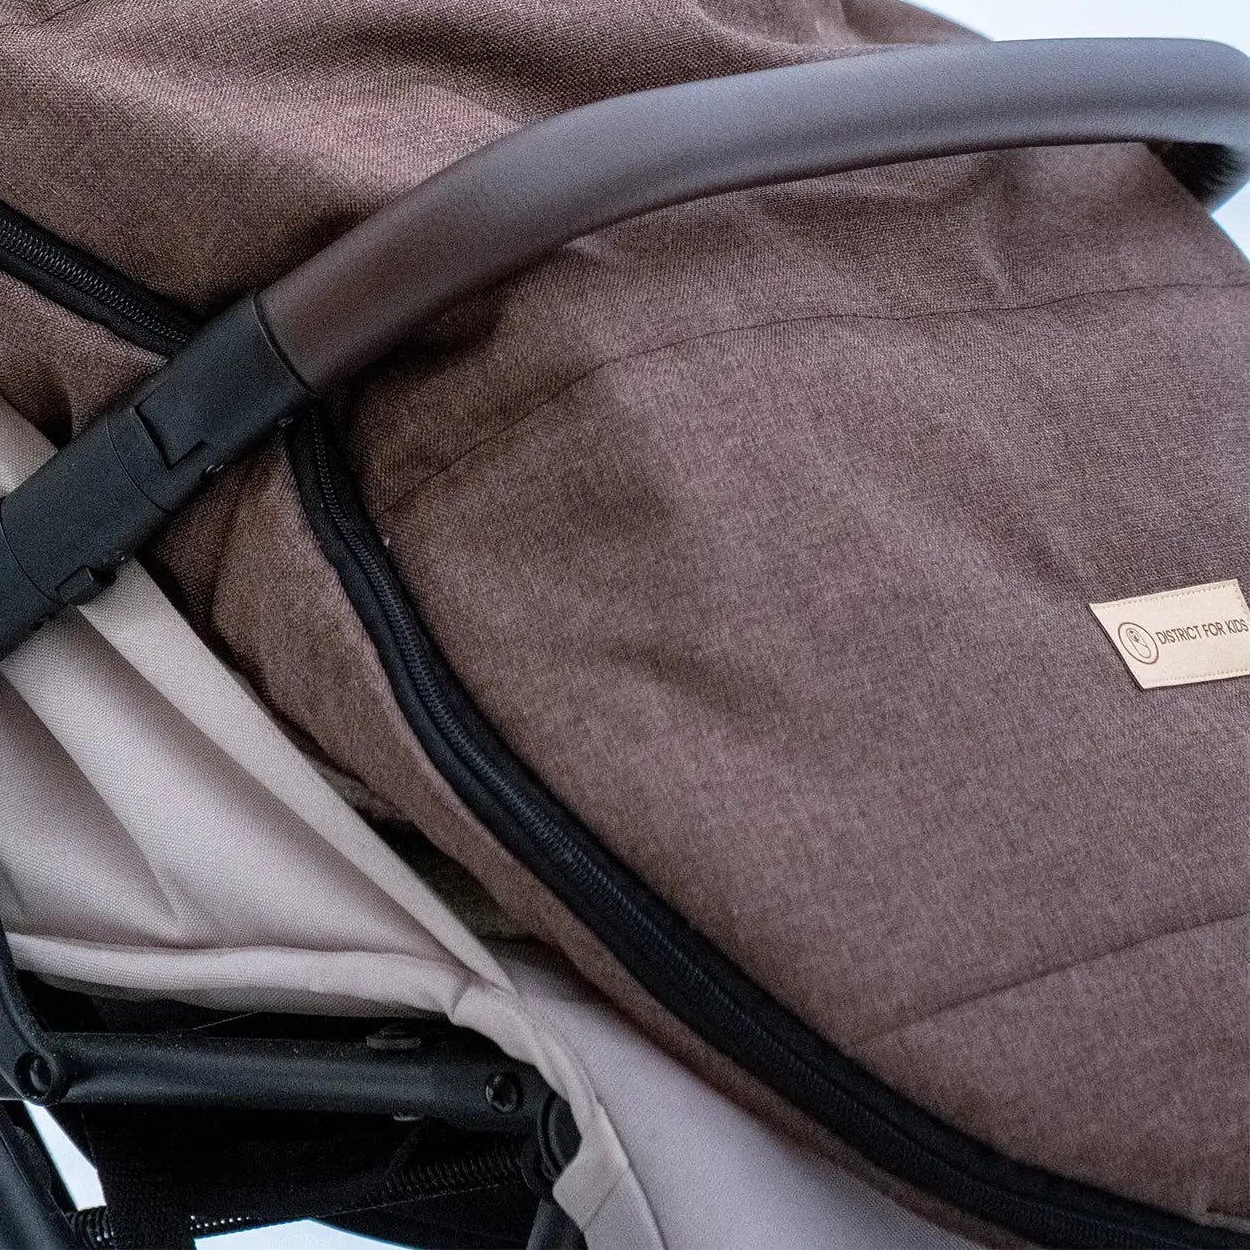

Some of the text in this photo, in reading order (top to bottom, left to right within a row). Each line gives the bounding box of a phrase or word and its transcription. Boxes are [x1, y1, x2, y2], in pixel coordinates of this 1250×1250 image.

[1155, 619, 1249, 645] DISTRICT FOR KIDS
